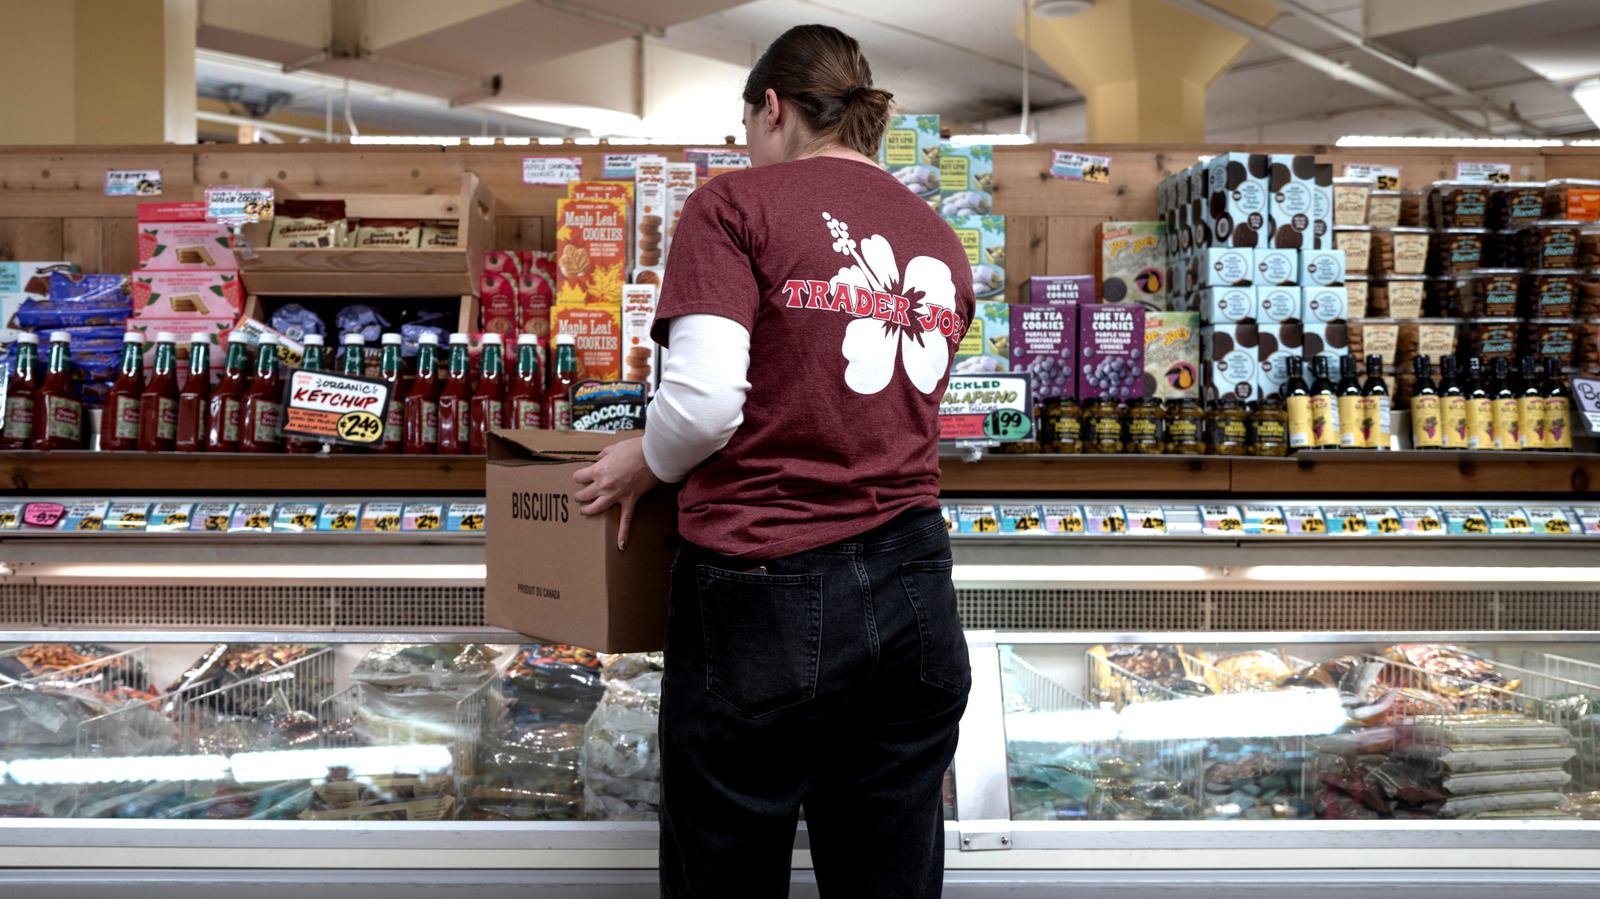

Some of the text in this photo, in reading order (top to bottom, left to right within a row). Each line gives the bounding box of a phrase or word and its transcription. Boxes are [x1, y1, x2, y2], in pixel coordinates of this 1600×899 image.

[564, 211, 617, 228] Maple Leaf
[582, 228, 622, 241] COOKIES
[782, 280, 911, 326] TRADER
[1023, 312, 1063, 321] UBE TEA
[1093, 312, 1133, 321] UBE TEA
[558, 319, 591, 337] Maple
[590, 319, 612, 335] Leaf
[1022, 321, 1064, 330] COOKIES
[1092, 321, 1134, 331] COOKIES
[577, 336, 618, 350] COOKIES
[949, 381, 1001, 390] ICKLED
[293, 387, 379, 409] KETCHUP
[940, 391, 1018, 404] ALAPENO
[572, 404, 642, 430] BROCCOLI
[938, 405, 965, 415] epper
[340, 414, 379, 438] $2.49
[512, 492, 569, 523] BISCUITS
[517, 583, 561, 600] PRODUIT DU CANADA
